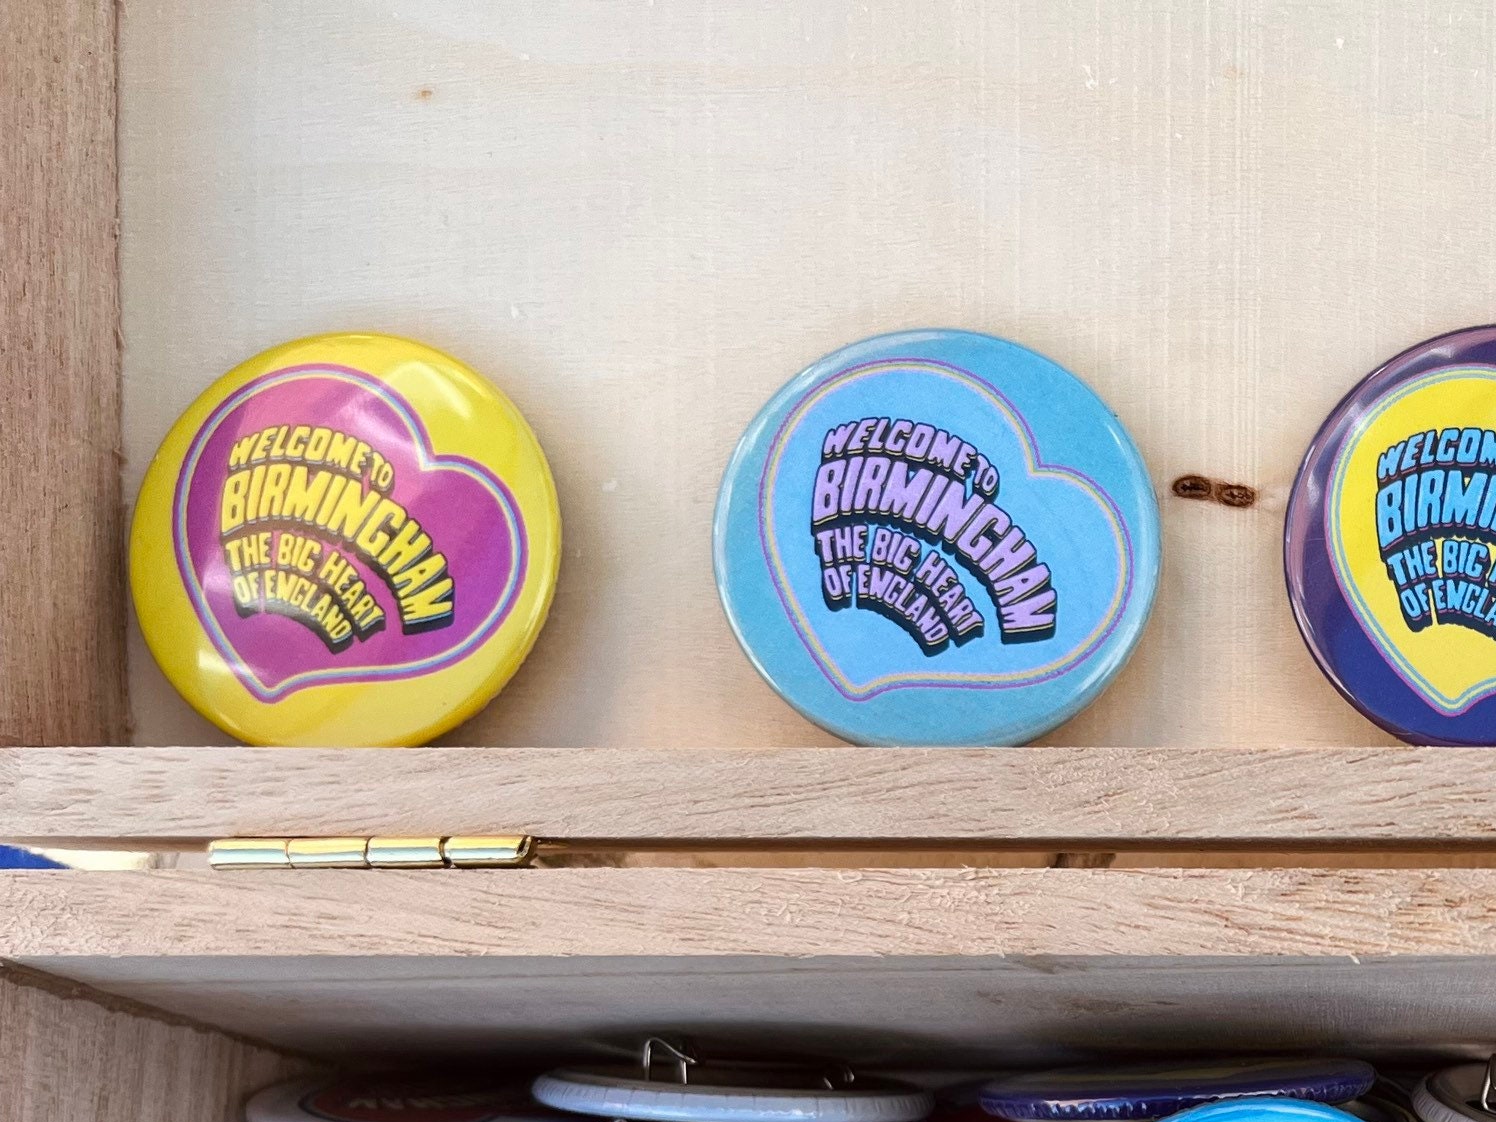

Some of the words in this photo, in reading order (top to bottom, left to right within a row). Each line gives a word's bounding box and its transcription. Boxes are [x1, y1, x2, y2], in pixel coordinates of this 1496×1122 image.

[229, 426, 370, 470] WELCOME
[369, 453, 393, 489] TO
[824, 418, 977, 476] WELCOME
[974, 456, 999, 493] TO
[222, 465, 454, 623] BIRMINGHAM
[226, 532, 272, 571] THE
[276, 534, 322, 572] BIG
[322, 552, 386, 629] HEART
[813, 456, 1056, 632] BIRMINGHAM
[816, 525, 868, 564] THE
[872, 528, 920, 573] BIG
[916, 551, 984, 634] HEART
[1387, 540, 1436, 586] THE
[1442, 540, 1489, 578] BIG
[233, 572, 264, 604] OF
[263, 570, 353, 643] ENGLAND
[824, 564, 852, 598] OF
[858, 564, 950, 643] ENGLAND
[1400, 582, 1430, 618] OF
